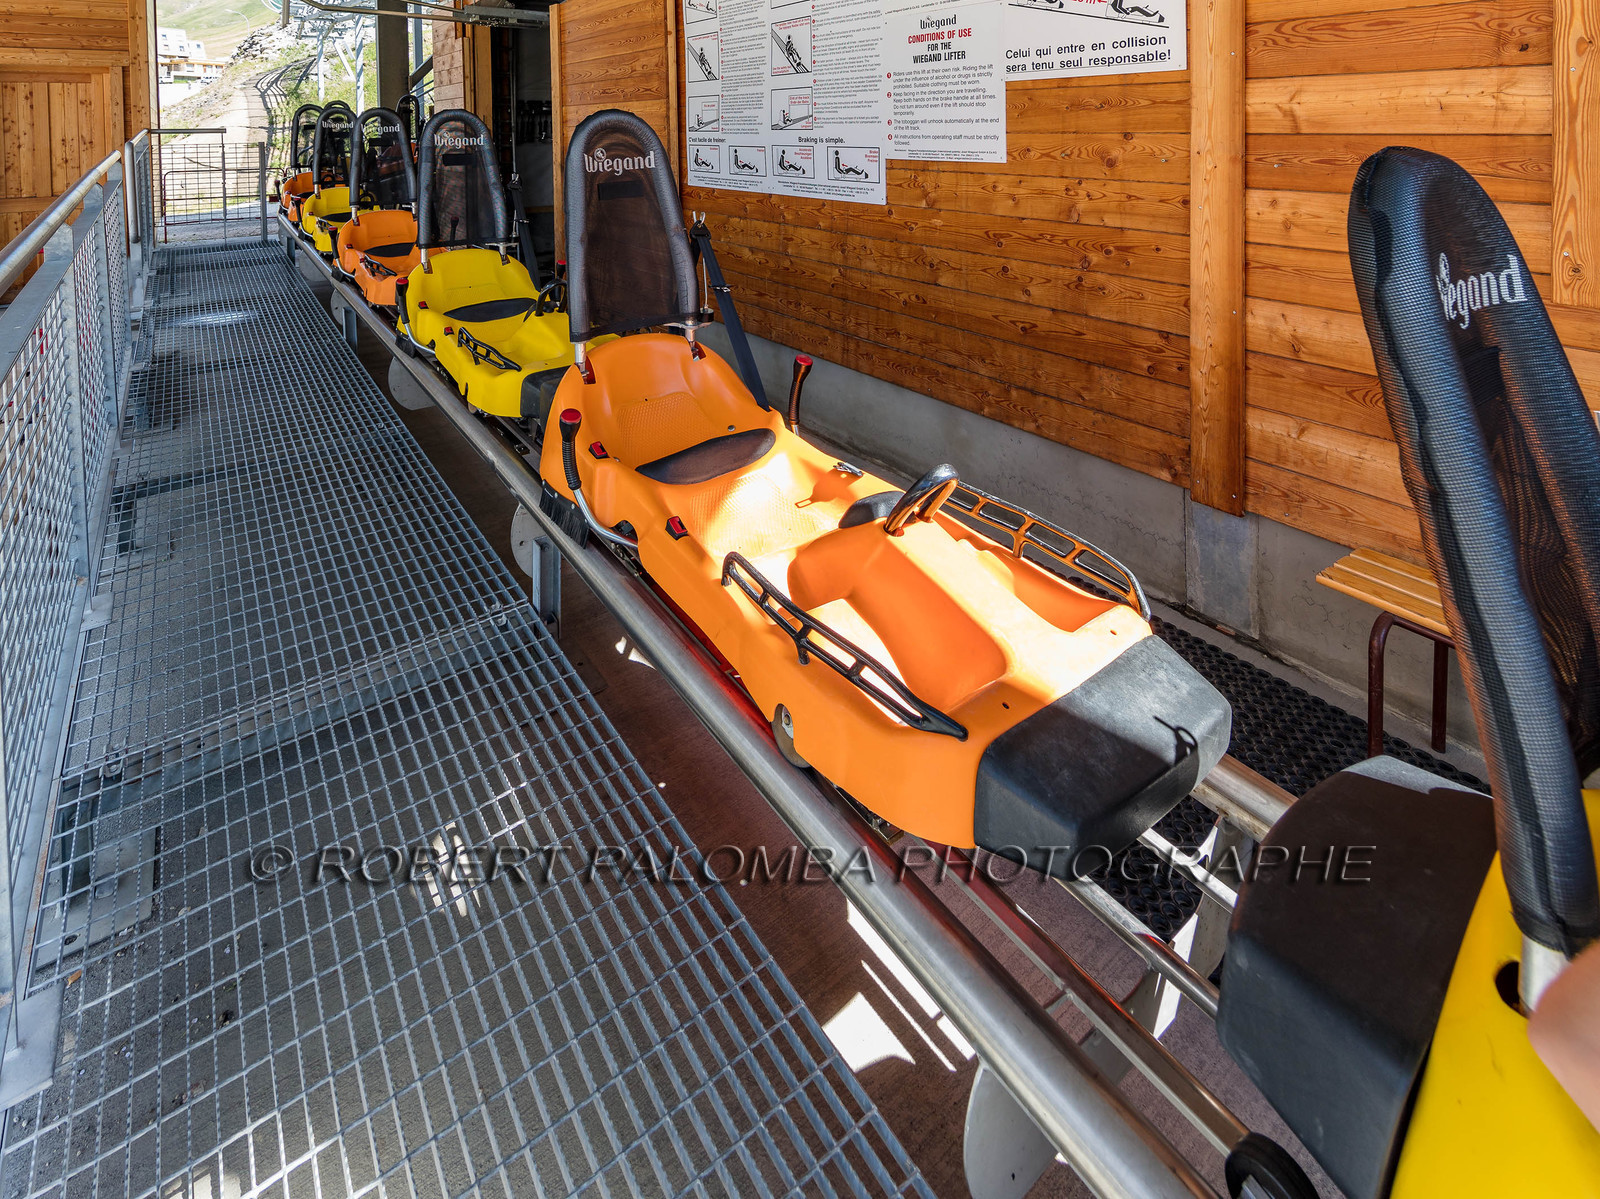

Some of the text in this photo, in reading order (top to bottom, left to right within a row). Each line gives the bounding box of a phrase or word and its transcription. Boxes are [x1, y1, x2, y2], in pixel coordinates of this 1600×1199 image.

[920, 14, 956, 30] Wiegand
[908, 28, 971, 44] CONDITIONS OF USE
[928, 42, 951, 51] FOR THE
[1006, 36, 1166, 59] Celui qui entre en collision
[913, 51, 966, 63] WIEGAND LIFTER
[1006, 50, 1171, 72] sera tenu seul responsable!
[434, 132, 484, 149] Wiegand
[825, 137, 845, 145] simple.
[584, 149, 656, 176] Wiegand
